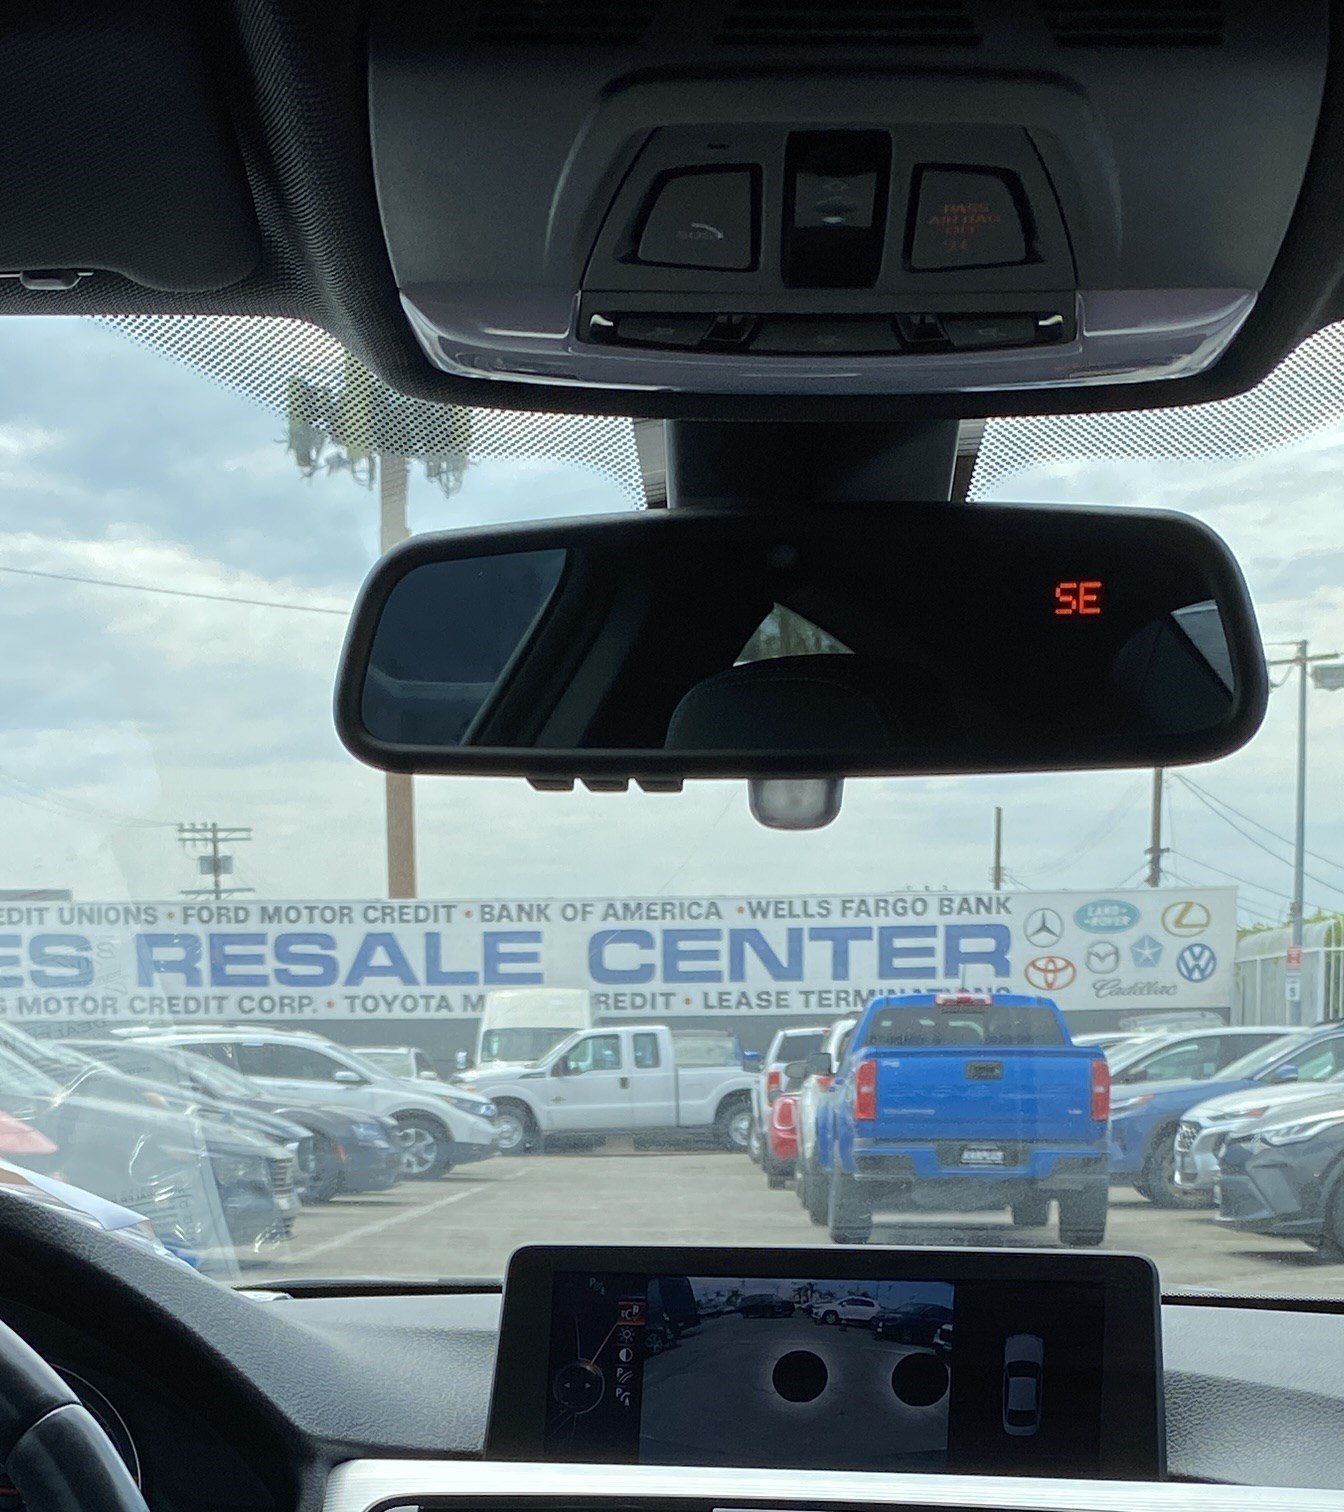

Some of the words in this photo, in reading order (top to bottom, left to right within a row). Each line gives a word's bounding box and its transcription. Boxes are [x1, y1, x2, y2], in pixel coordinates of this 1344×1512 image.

[1054, 581, 1102, 614] SE
[59, 904, 158, 926] UNIONS
[181, 904, 250, 925] FORD
[260, 904, 355, 924] MOTOR
[363, 903, 457, 924] CREDIT
[479, 903, 551, 923] BANK
[561, 902, 593, 922] OF
[603, 900, 723, 922] AMERICA
[748, 898, 832, 920] WELLS
[841, 897, 928, 918] FARGO
[938, 896, 1012, 917] BANK
[135, 931, 544, 988] RESALE
[588, 923, 1012, 986] CENTER
[703, 991, 789, 1011] LEASE
[1093, 978, 1177, 998] Cadillac
[18, 996, 118, 1017] MOTOR
[129, 995, 230, 1016] CREDIT
[238, 994, 317, 1016] CORP.
[345, 994, 454, 1015] TOYOTA
